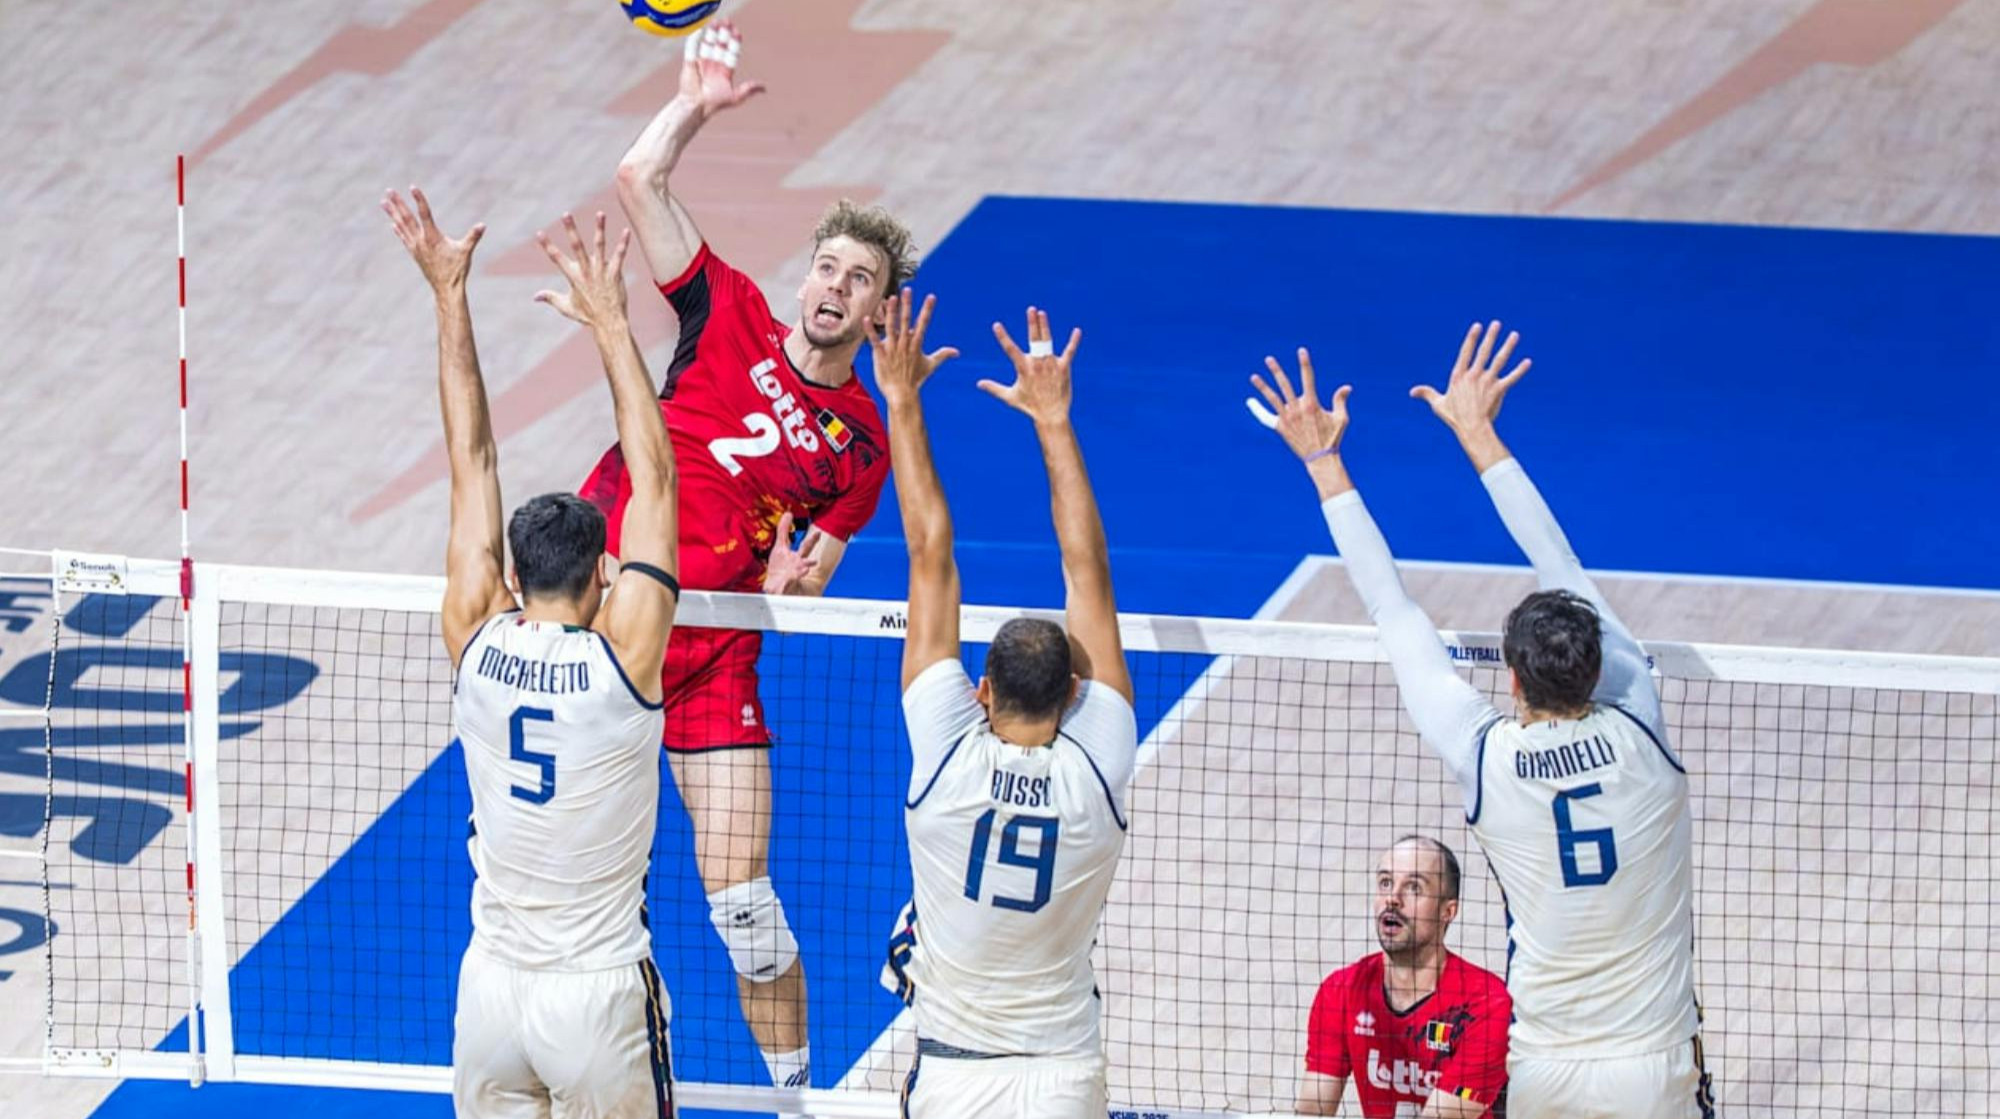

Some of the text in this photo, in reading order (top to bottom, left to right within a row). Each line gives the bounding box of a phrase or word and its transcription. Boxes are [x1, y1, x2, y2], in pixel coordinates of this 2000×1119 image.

[707, 411, 781, 478] 2
[749, 357, 819, 453] lotto
[1445, 645, 1502, 662] OLLEYBALL
[509, 705, 556, 806] 5
[964, 808, 1060, 914] 19
[1552, 782, 1618, 888] 6
